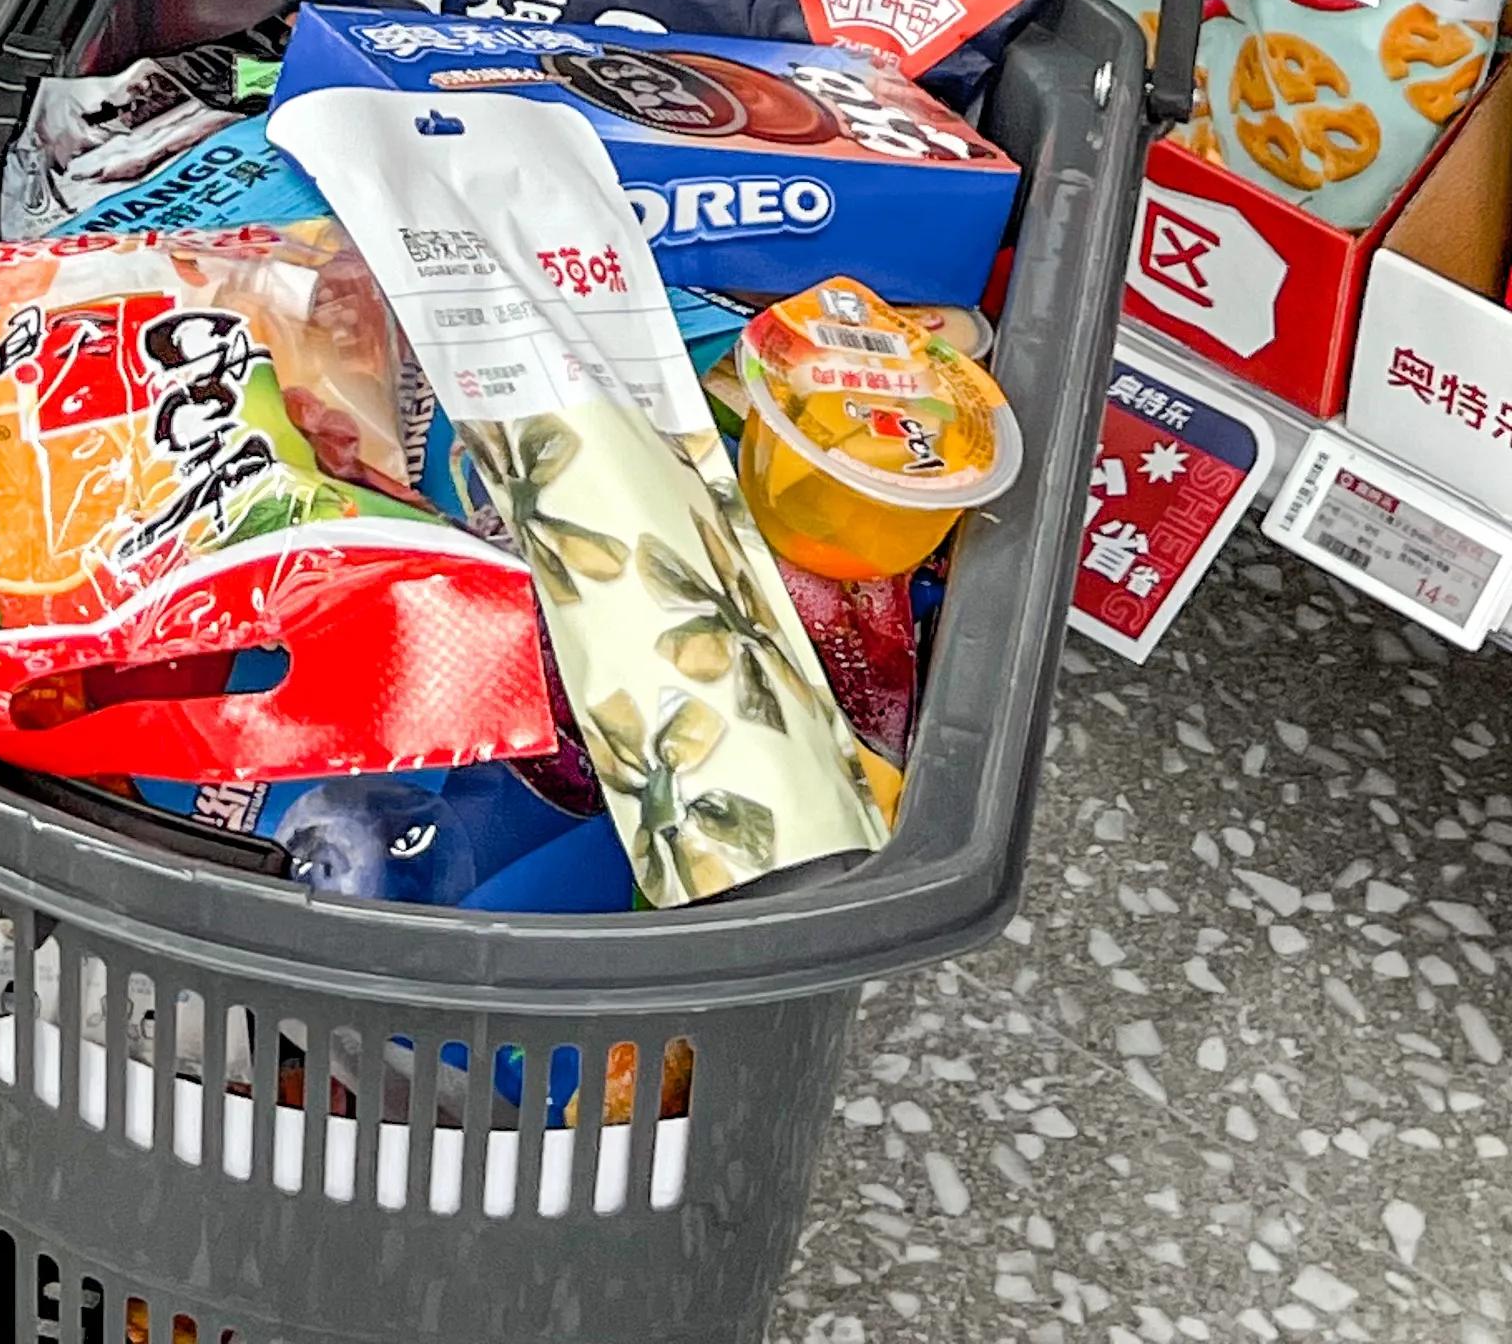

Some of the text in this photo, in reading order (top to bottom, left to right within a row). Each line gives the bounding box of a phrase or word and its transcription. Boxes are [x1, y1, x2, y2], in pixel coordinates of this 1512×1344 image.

[86, 144, 245, 234] MANGO
[536, 244, 629, 297] 百草味
[1107, 373, 1195, 432] 奥特乐
